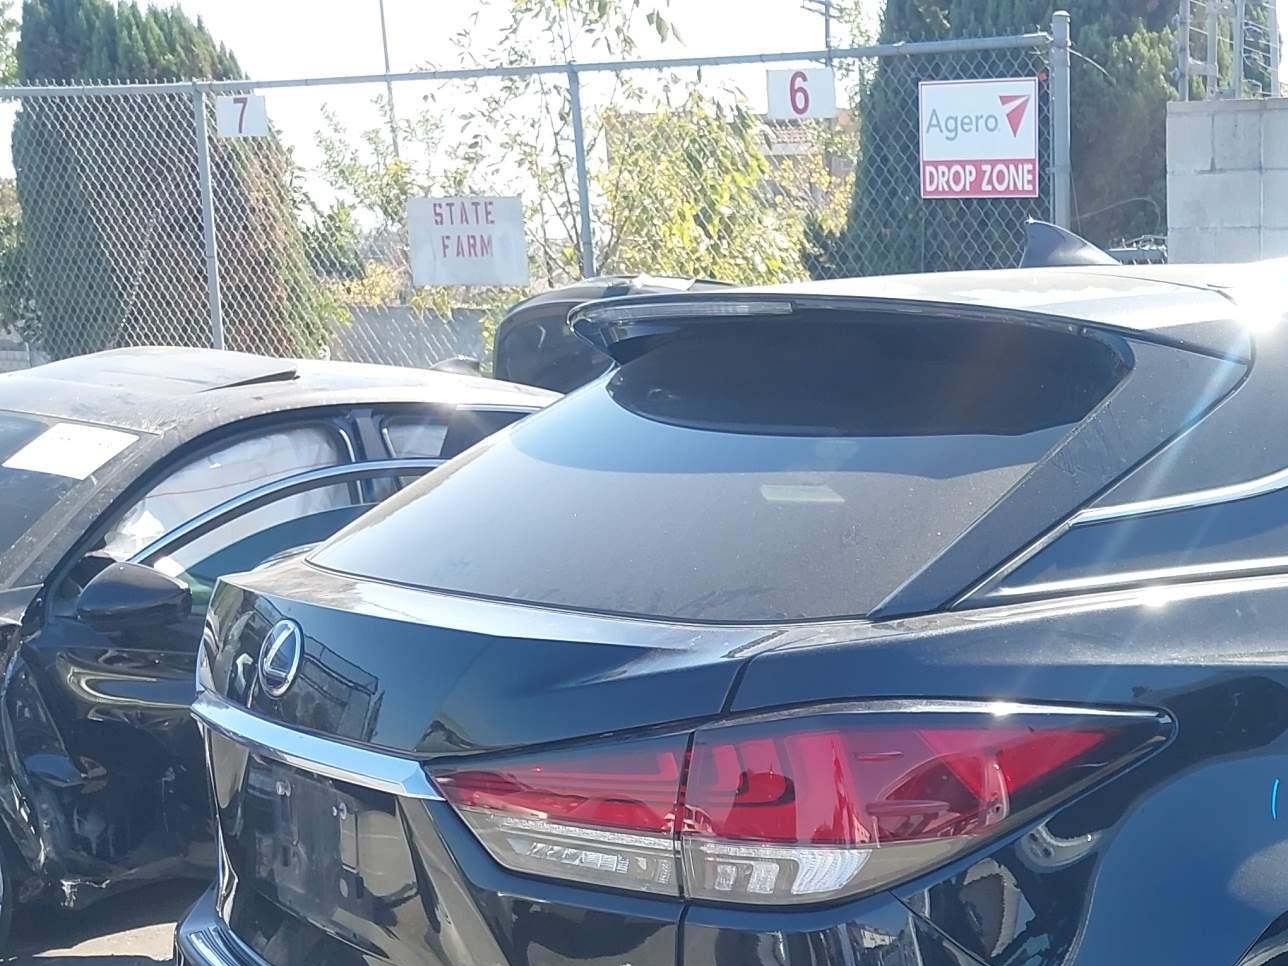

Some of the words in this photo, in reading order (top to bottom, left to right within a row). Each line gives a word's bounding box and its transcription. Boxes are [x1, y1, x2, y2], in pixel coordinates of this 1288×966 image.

[789, 71, 810, 116] 6
[232, 97, 249, 134] 7
[926, 108, 999, 142] Agero
[924, 164, 977, 192] DROP
[981, 163, 1034, 191] ZONE
[432, 201, 496, 226] STATE
[441, 234, 494, 258] FARM
